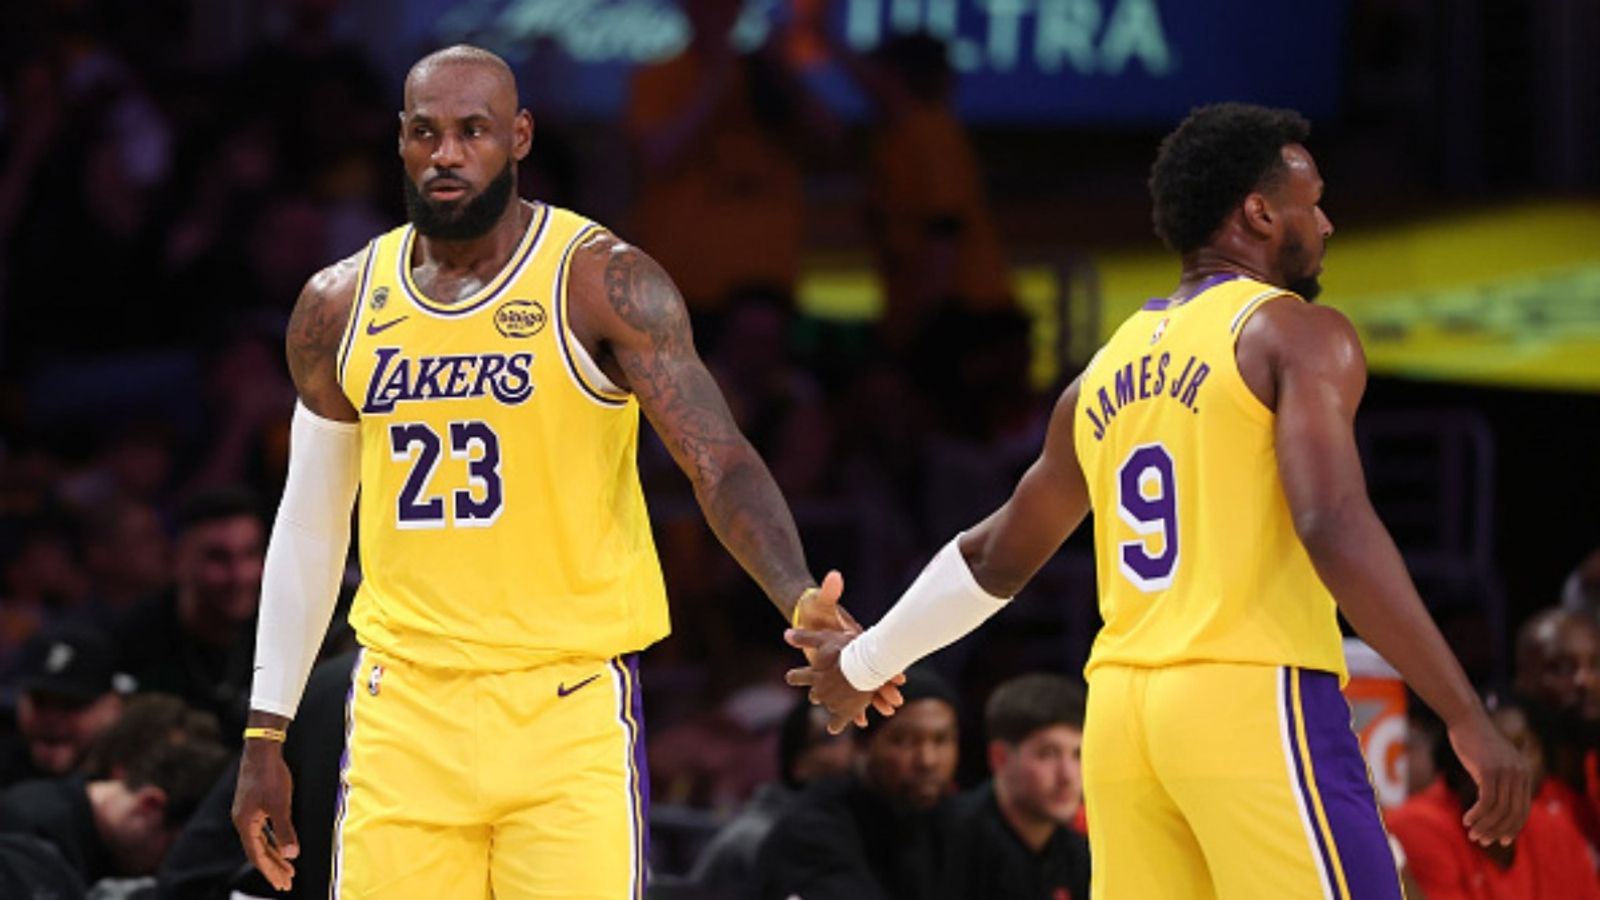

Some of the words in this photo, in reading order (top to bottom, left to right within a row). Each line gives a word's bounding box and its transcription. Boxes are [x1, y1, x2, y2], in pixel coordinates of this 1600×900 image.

[361, 346, 535, 413] LAKERS
[1086, 351, 1171, 441] JAMES
[1169, 356, 1210, 414] JR.
[388, 421, 505, 529] 23
[1116, 442, 1181, 592] 9
